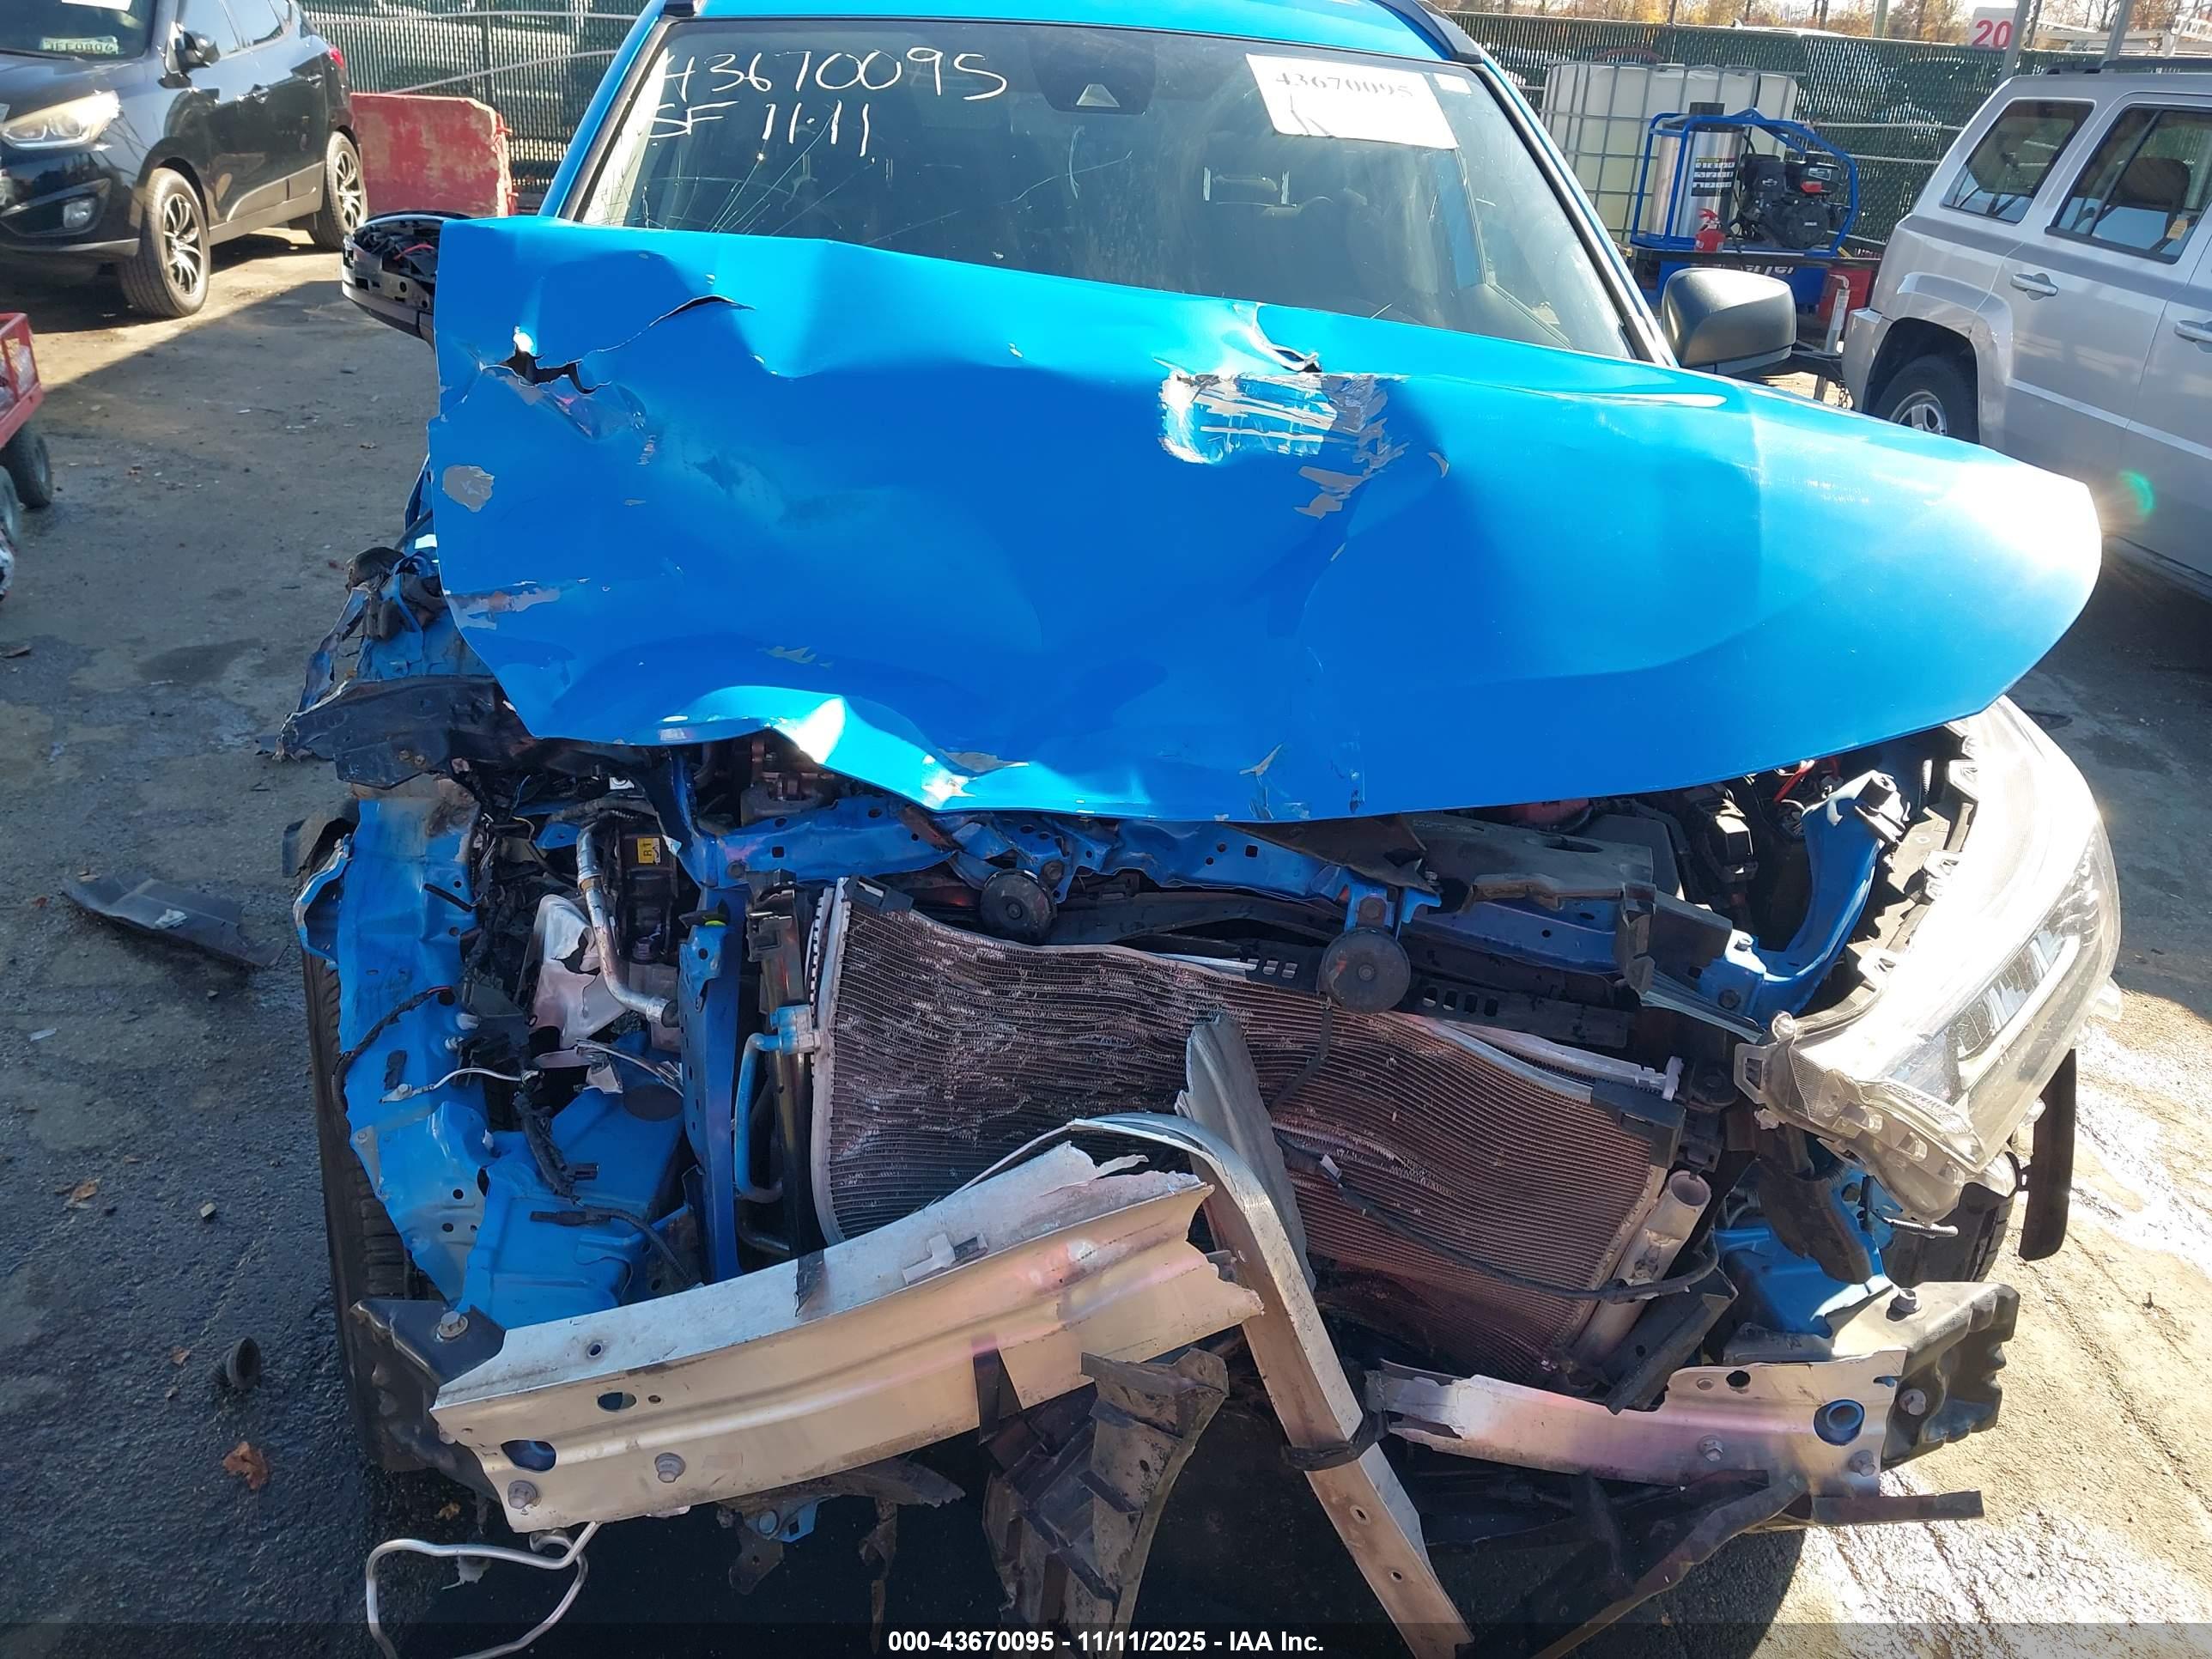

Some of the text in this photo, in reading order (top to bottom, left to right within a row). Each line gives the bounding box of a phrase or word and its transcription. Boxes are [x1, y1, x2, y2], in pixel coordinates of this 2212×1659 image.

[1972, 19, 2014, 48] 20
[663, 46, 1009, 102] 43670095
[648, 100, 738, 139] SF
